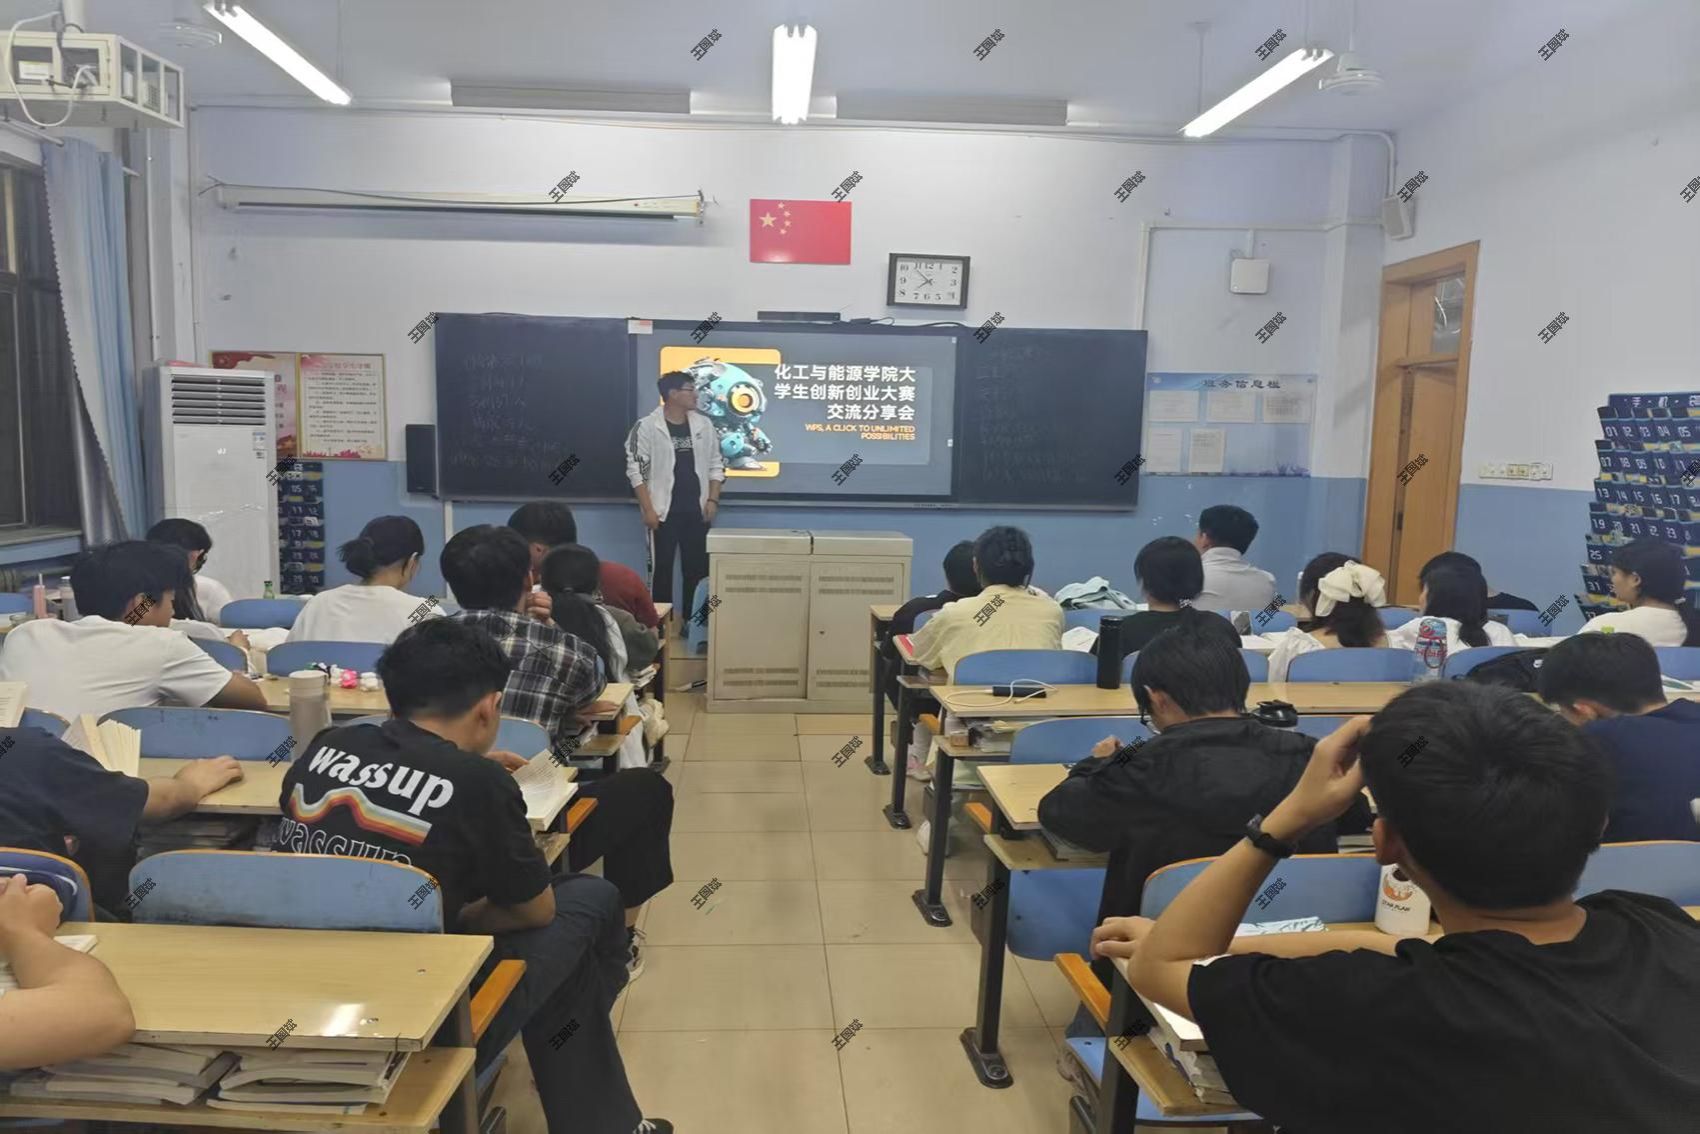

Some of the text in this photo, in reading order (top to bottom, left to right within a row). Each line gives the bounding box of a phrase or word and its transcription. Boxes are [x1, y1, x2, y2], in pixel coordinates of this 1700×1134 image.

[774, 364, 916, 382] 化工与能源学院大
[774, 383, 916, 402] 学生创新创业大赛
[827, 403, 916, 421] 交流分享会
[833, 424, 857, 432] CLICK
[859, 424, 870, 432] TO
[871, 424, 916, 433] UNLIMITED
[1605, 426, 1618, 437] 01
[1657, 425, 1671, 437] 04
[1678, 426, 1691, 437] 05
[861, 432, 916, 441] POSSIBILITIES
[1597, 488, 1610, 498] 13
[1616, 490, 1628, 501] 14
[1633, 491, 1645, 502] 15
[1650, 493, 1663, 504] 16
[1669, 494, 1681, 505] 17
[1592, 518, 1606, 529] 19
[1589, 550, 1602, 560] 25
[1587, 581, 1601, 591] 31
[308, 746, 454, 816] wassup
